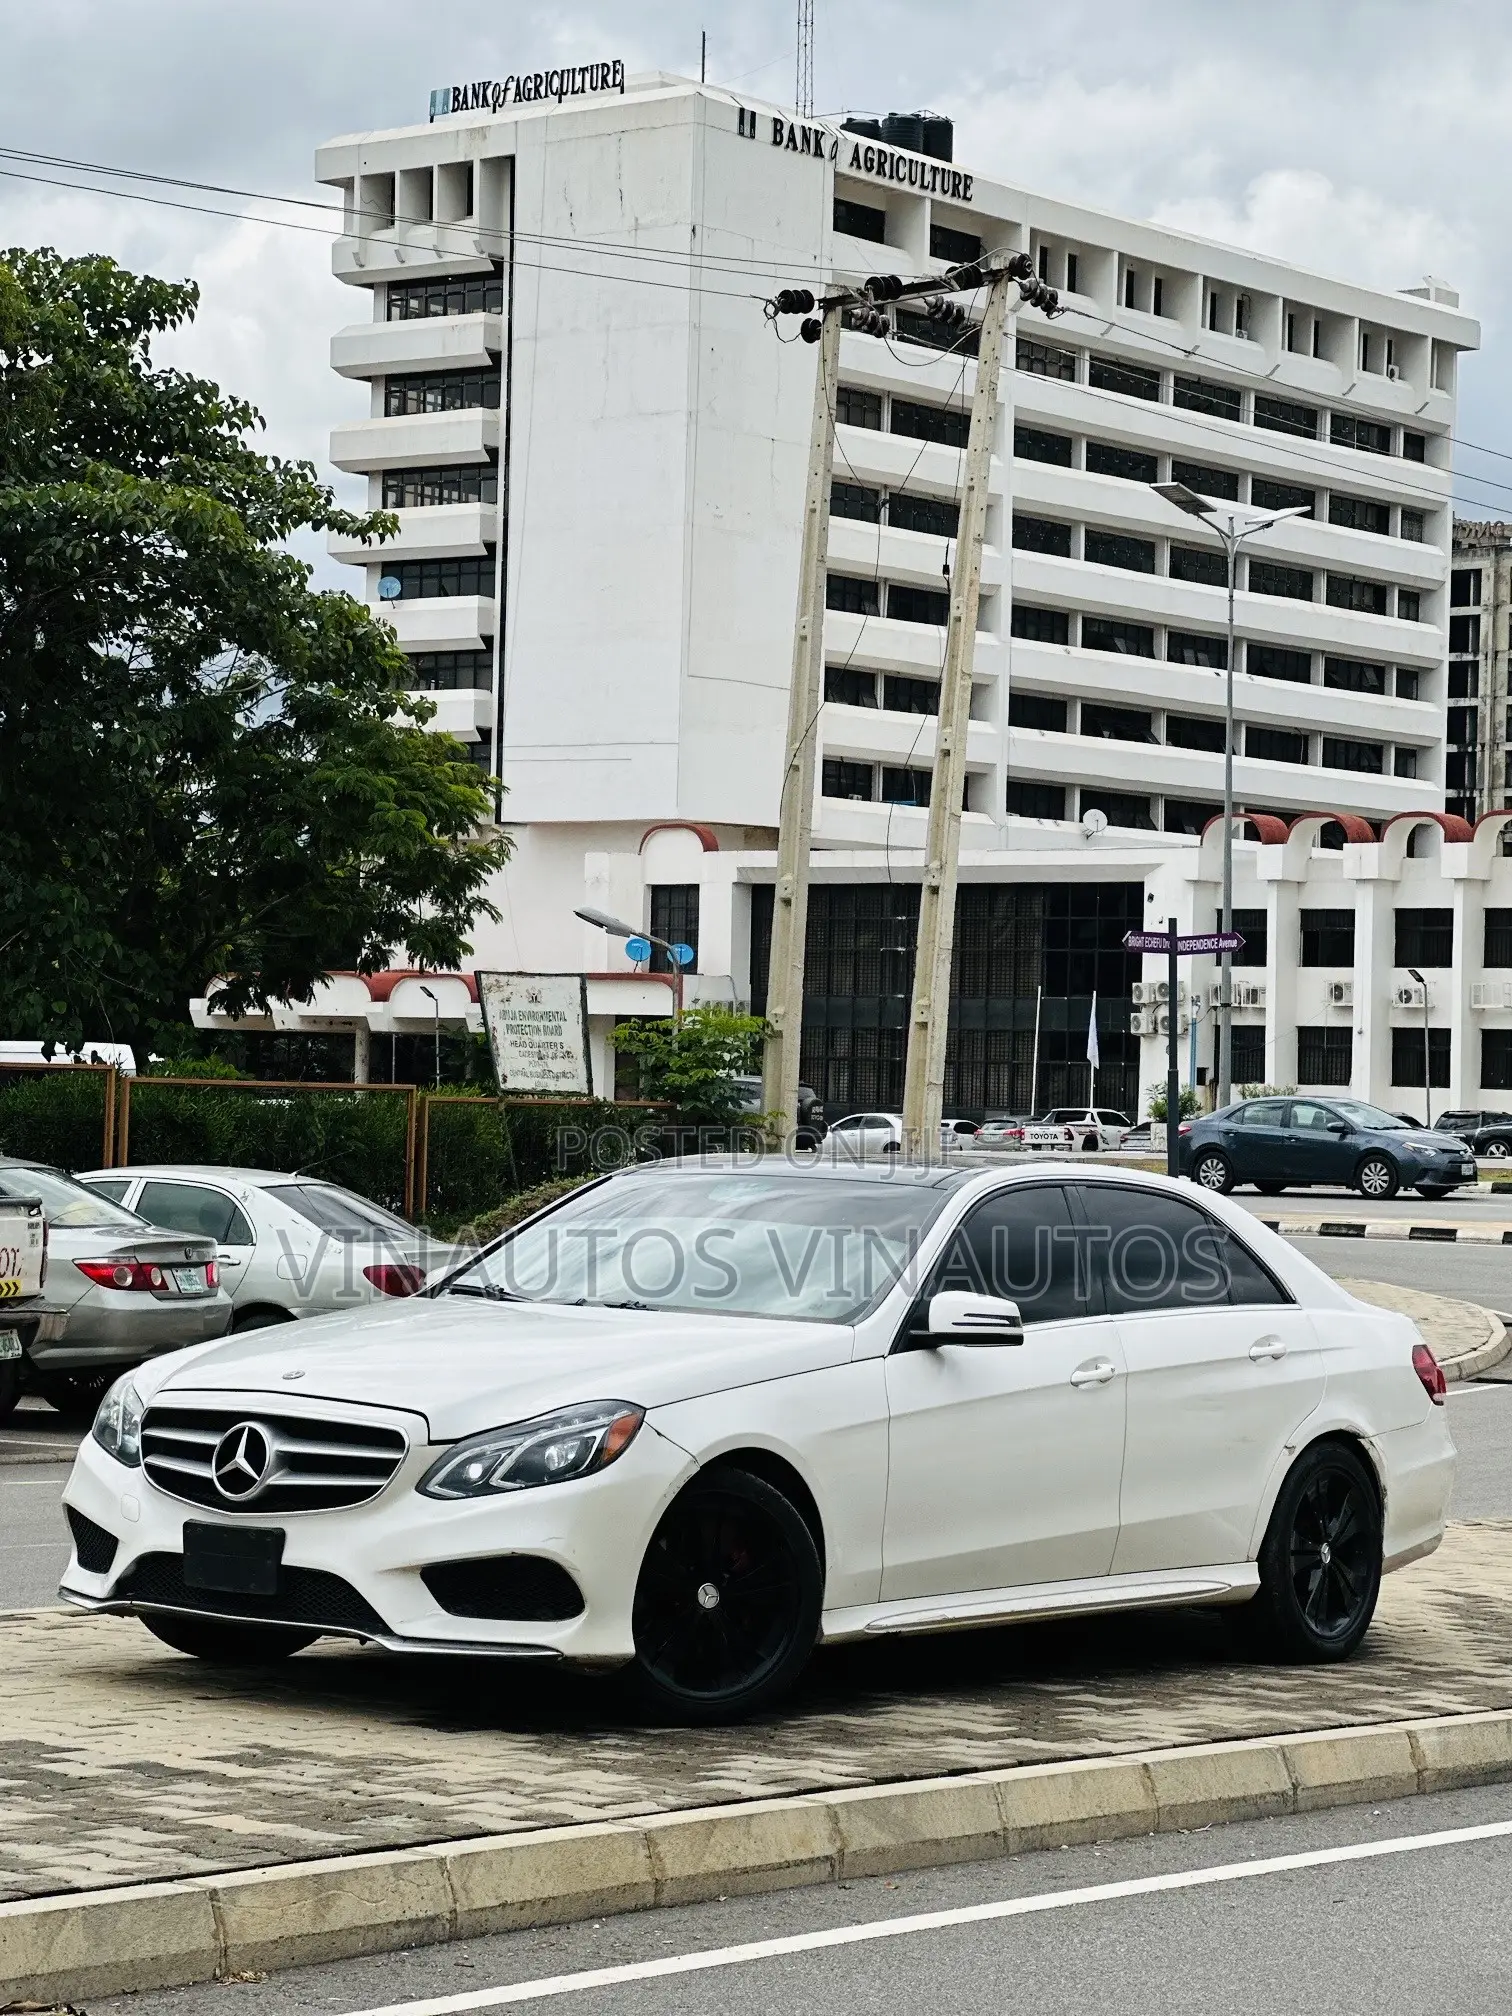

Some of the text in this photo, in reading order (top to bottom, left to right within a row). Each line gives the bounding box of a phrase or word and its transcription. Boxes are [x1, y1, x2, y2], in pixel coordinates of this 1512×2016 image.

[450, 59, 622, 113] BANK of AGRICULTURE
[771, 116, 825, 158] BANK
[849, 141, 974, 201] AGRICULTURE
[1128, 935, 1144, 947] BRIGHT
[1177, 937, 1238, 952] INDEPENDENCE Avenue
[1030, 1132, 1059, 1140] TOYOTA
